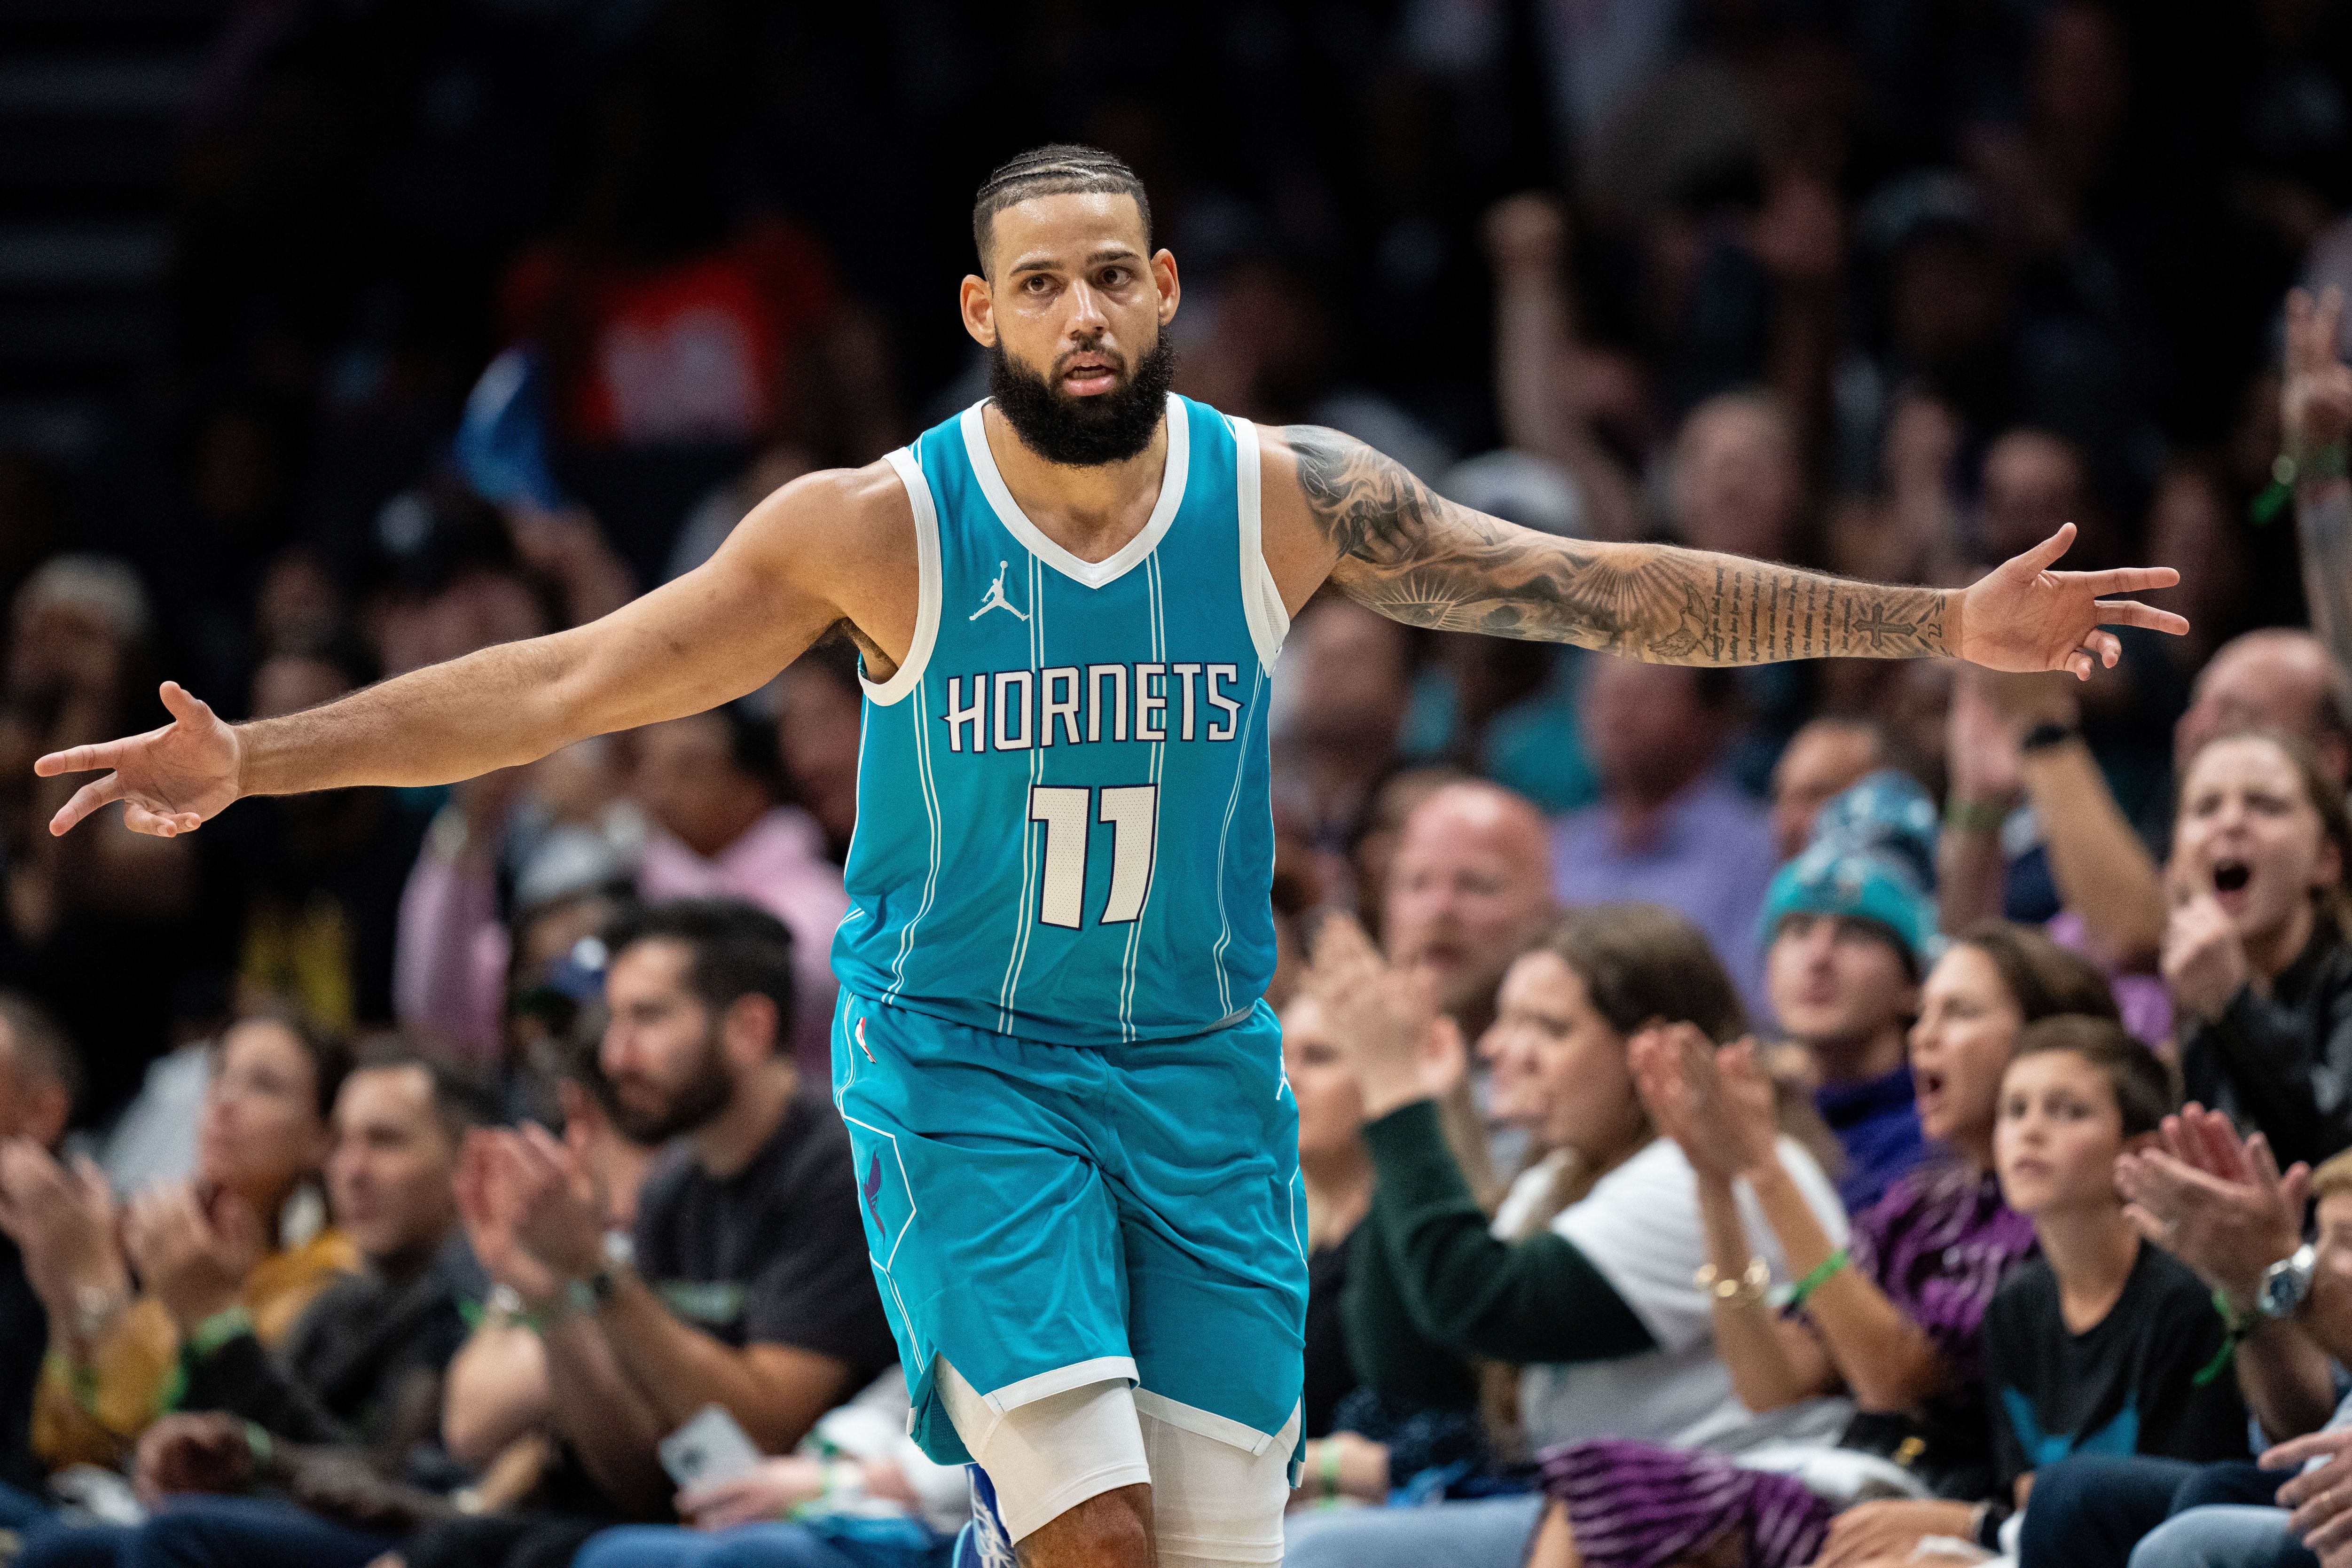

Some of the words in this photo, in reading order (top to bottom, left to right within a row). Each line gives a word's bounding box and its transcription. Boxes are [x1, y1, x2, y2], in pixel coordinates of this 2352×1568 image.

[1928, 623, 1942, 638] 22
[940, 662, 1243, 753] HORNETS
[1028, 784, 1158, 931] 11
